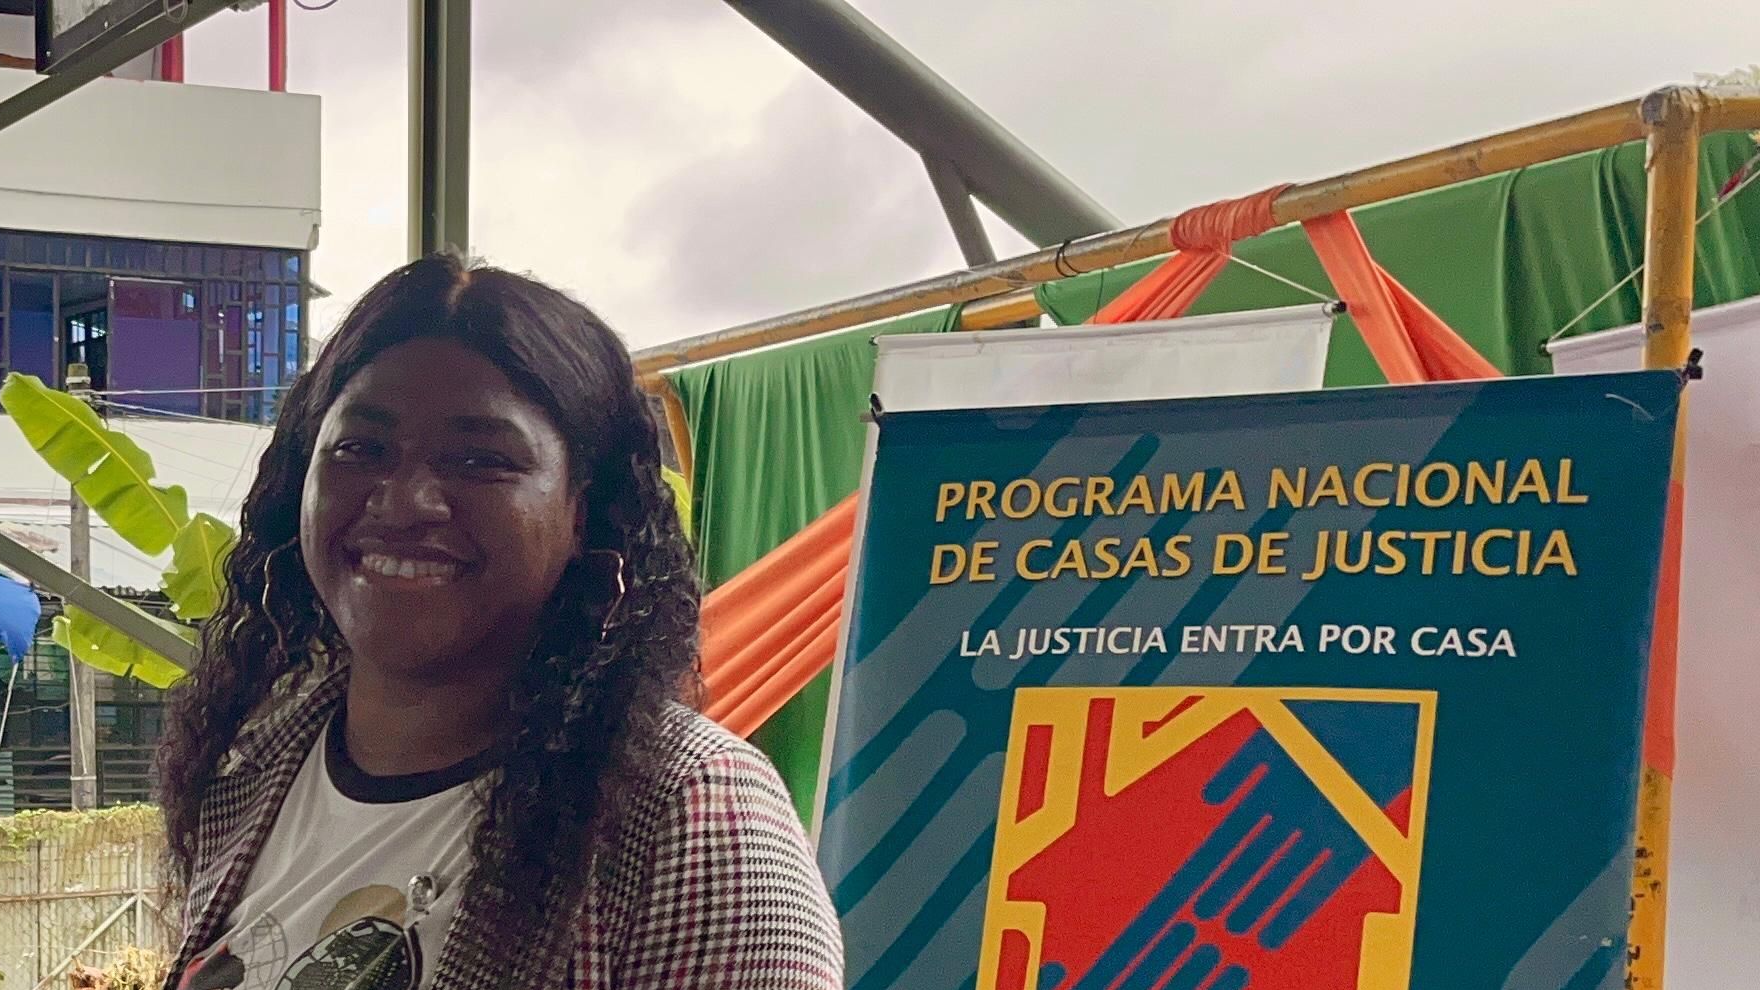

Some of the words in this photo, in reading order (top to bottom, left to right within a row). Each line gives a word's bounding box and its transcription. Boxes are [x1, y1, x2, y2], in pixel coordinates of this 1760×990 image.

[935, 469, 1246, 523] PROGRAMA
[1267, 458, 1590, 509] NACIONAL
[929, 541, 1000, 585] DE
[1015, 534, 1192, 581] CASAS
[1212, 532, 1290, 576] DE
[1301, 528, 1578, 581] JUSTICIA
[959, 629, 1002, 657] LA
[1008, 626, 1168, 660] JUSTICIA
[1180, 624, 1305, 654] ENTRA
[1318, 623, 1397, 655] POR
[1410, 626, 1518, 658] CASA
